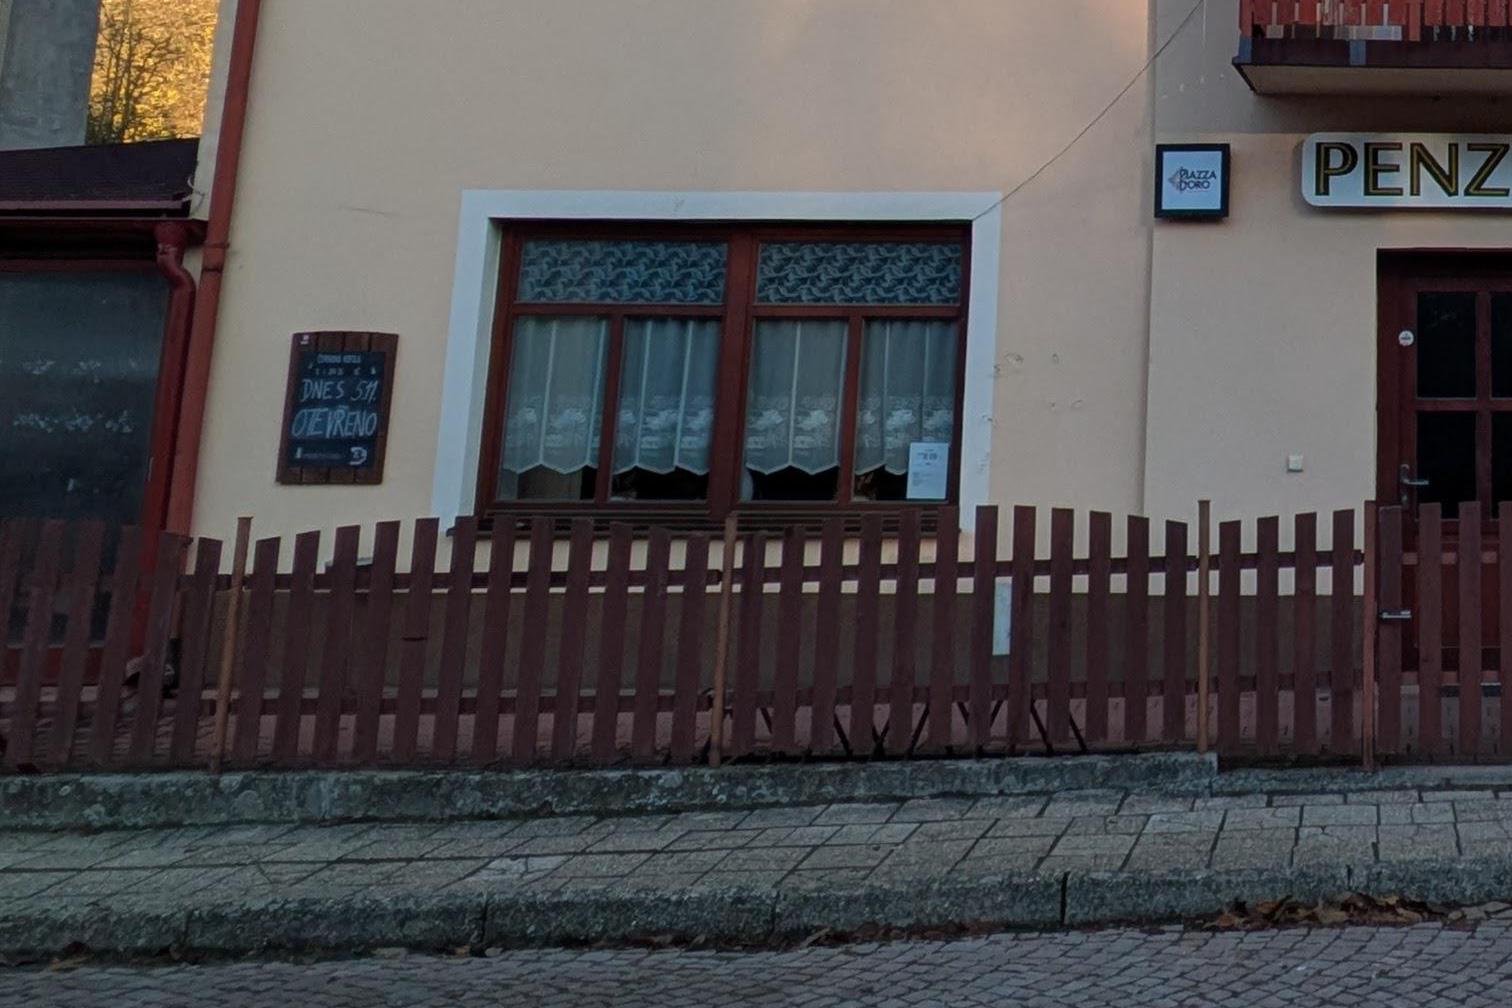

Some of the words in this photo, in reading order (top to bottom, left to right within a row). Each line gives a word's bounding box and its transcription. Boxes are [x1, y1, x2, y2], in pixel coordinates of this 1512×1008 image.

[1180, 168, 1217, 180] PIAZZA
[300, 379, 345, 402] DNES
[292, 405, 378, 438] OTEVŘENO
